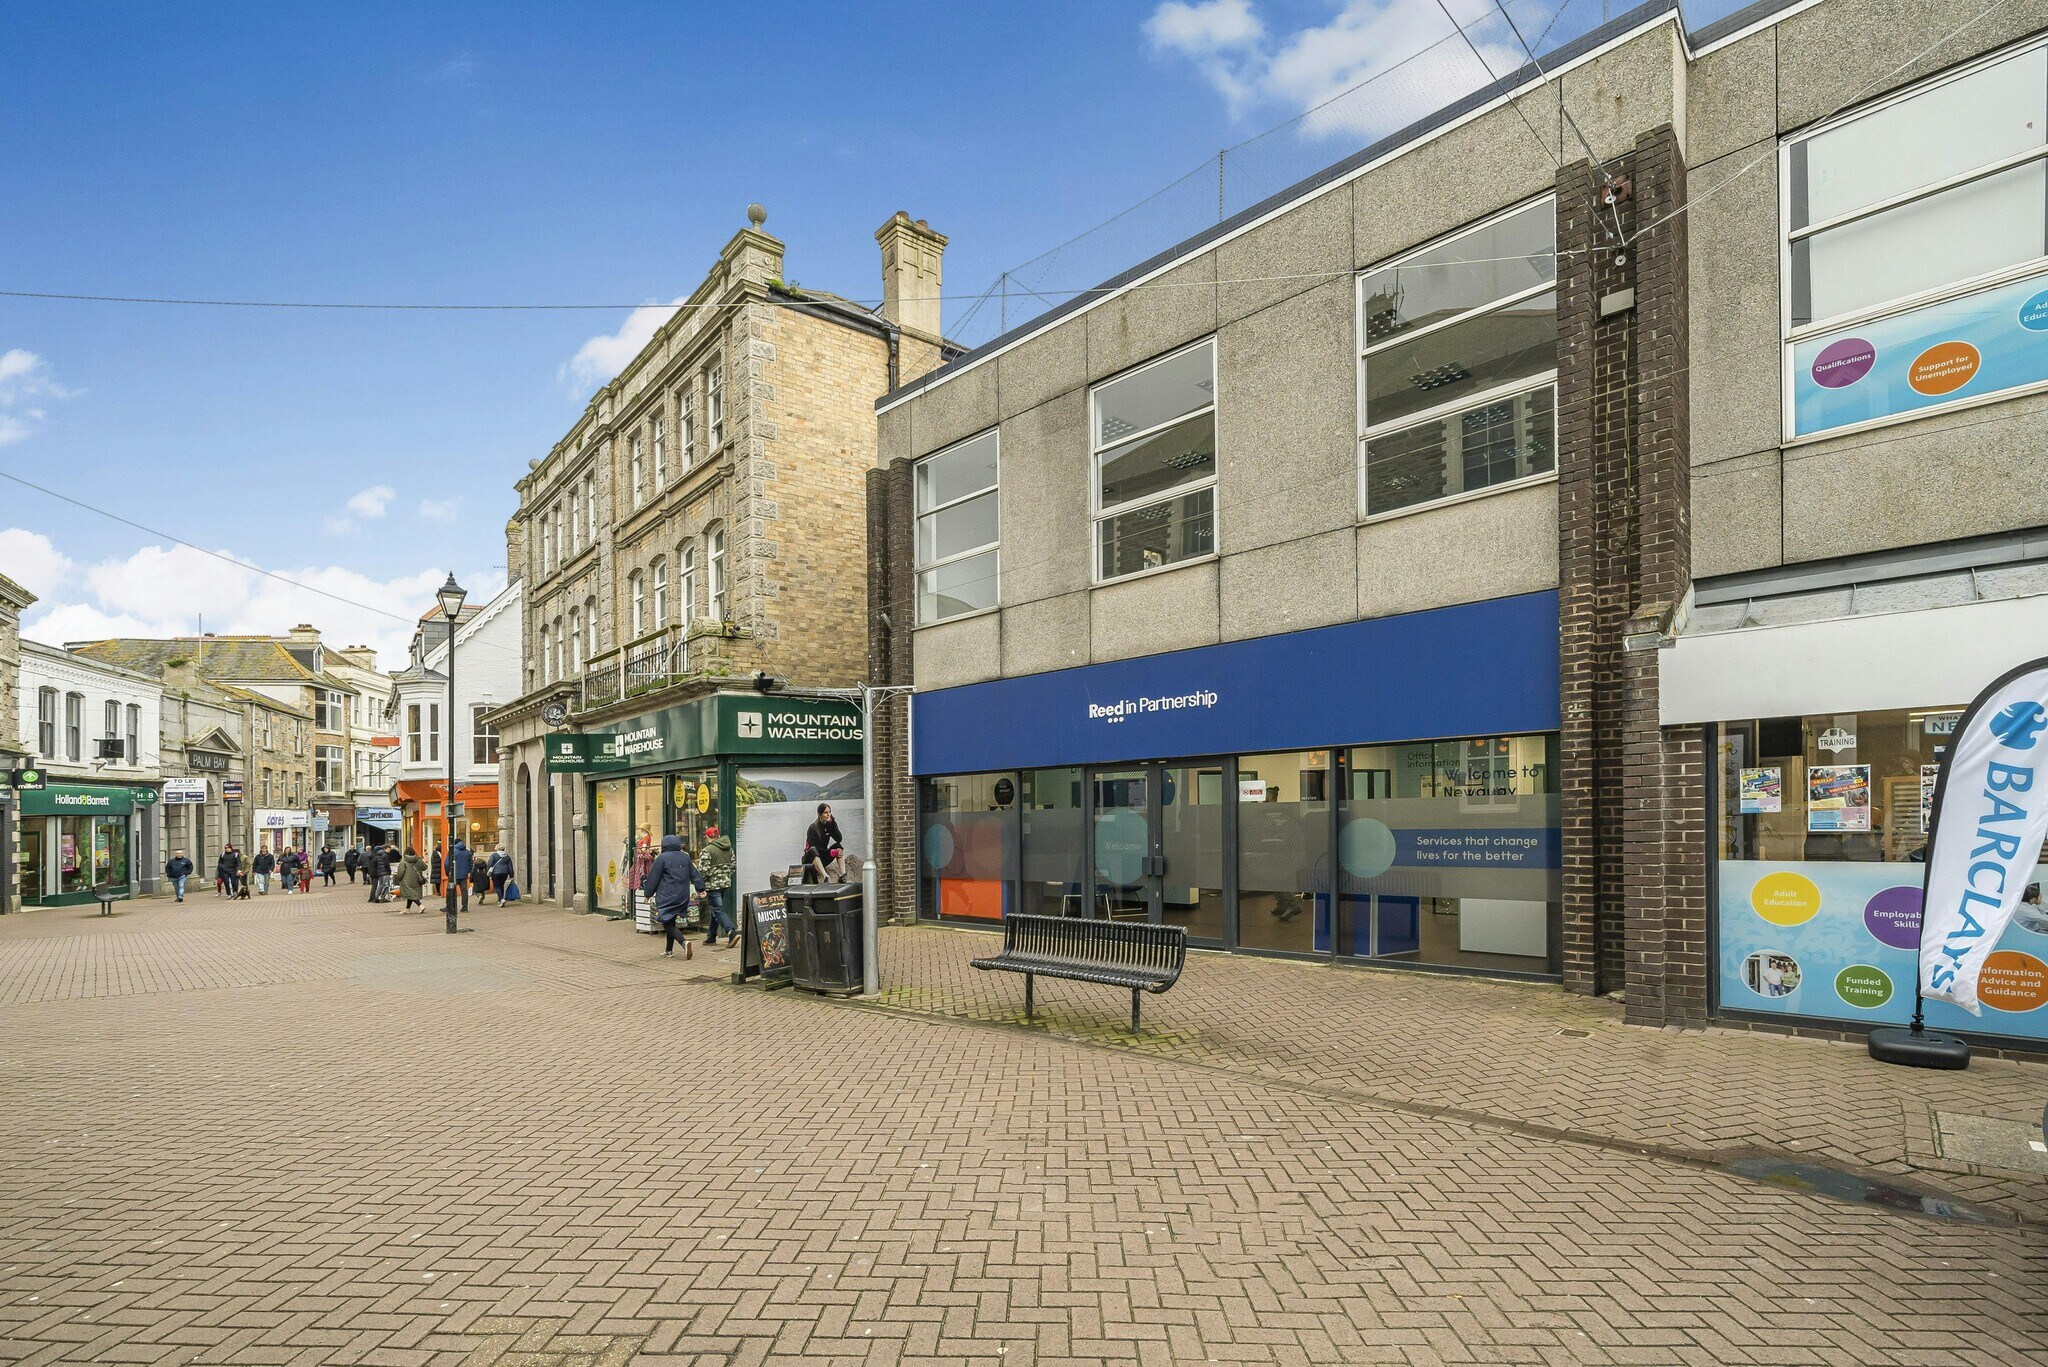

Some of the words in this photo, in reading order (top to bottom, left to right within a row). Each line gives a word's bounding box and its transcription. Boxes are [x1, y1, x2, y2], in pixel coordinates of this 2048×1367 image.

[2034, 301, 2048, 311] Ad
[2023, 311, 2048, 322] Educ
[1815, 353, 1872, 372] Qualifications
[1918, 359, 1954, 374] Support
[1955, 355, 1970, 364] for
[1915, 362, 1973, 382] Unemployed
[1088, 700, 1124, 718] Reed
[1125, 700, 1137, 715] in
[1139, 690, 1218, 713] Partnership
[768, 713, 857, 727] MOUNTAIN
[1932, 722, 1958, 732] NE
[624, 727, 657, 743] MOUNTAIN
[768, 727, 863, 740] WAREHOUS
[624, 738, 664, 755] WAREHOUSE
[1819, 738, 1855, 747] TRAINING
[193, 754, 211, 768] PALM
[213, 756, 226, 769] BAY
[1445, 768, 1517, 781] Welcome
[1522, 765, 1540, 778] to
[55, 794, 82, 805] Holland
[86, 794, 110, 806] Barrett
[1104, 841, 1142, 851] Welcome
[1416, 836, 1462, 846] Services
[1464, 836, 1490, 846] that
[1493, 836, 1538, 848] change
[1416, 850, 1440, 860] lives
[1442, 850, 1459, 860] for
[1462, 850, 1482, 861] the
[1485, 850, 1525, 861] better
[1931, 760, 2034, 994] BARCLAYS
[1773, 890, 1797, 898] Adult
[754, 896, 768, 905] THE
[1764, 898, 1808, 907] Education
[757, 909, 781, 923] MUSIC
[781, 908, 788, 919] S
[1873, 910, 1922, 920] Employab
[1894, 920, 1920, 929] Skills
[1980, 967, 2045, 979] nformation,
[1846, 976, 1882, 986] Funded
[1980, 976, 2017, 987] Advice
[2020, 980, 2041, 988] and
[1844, 986, 1884, 998] Training
[1984, 987, 2037, 998] Guidance
